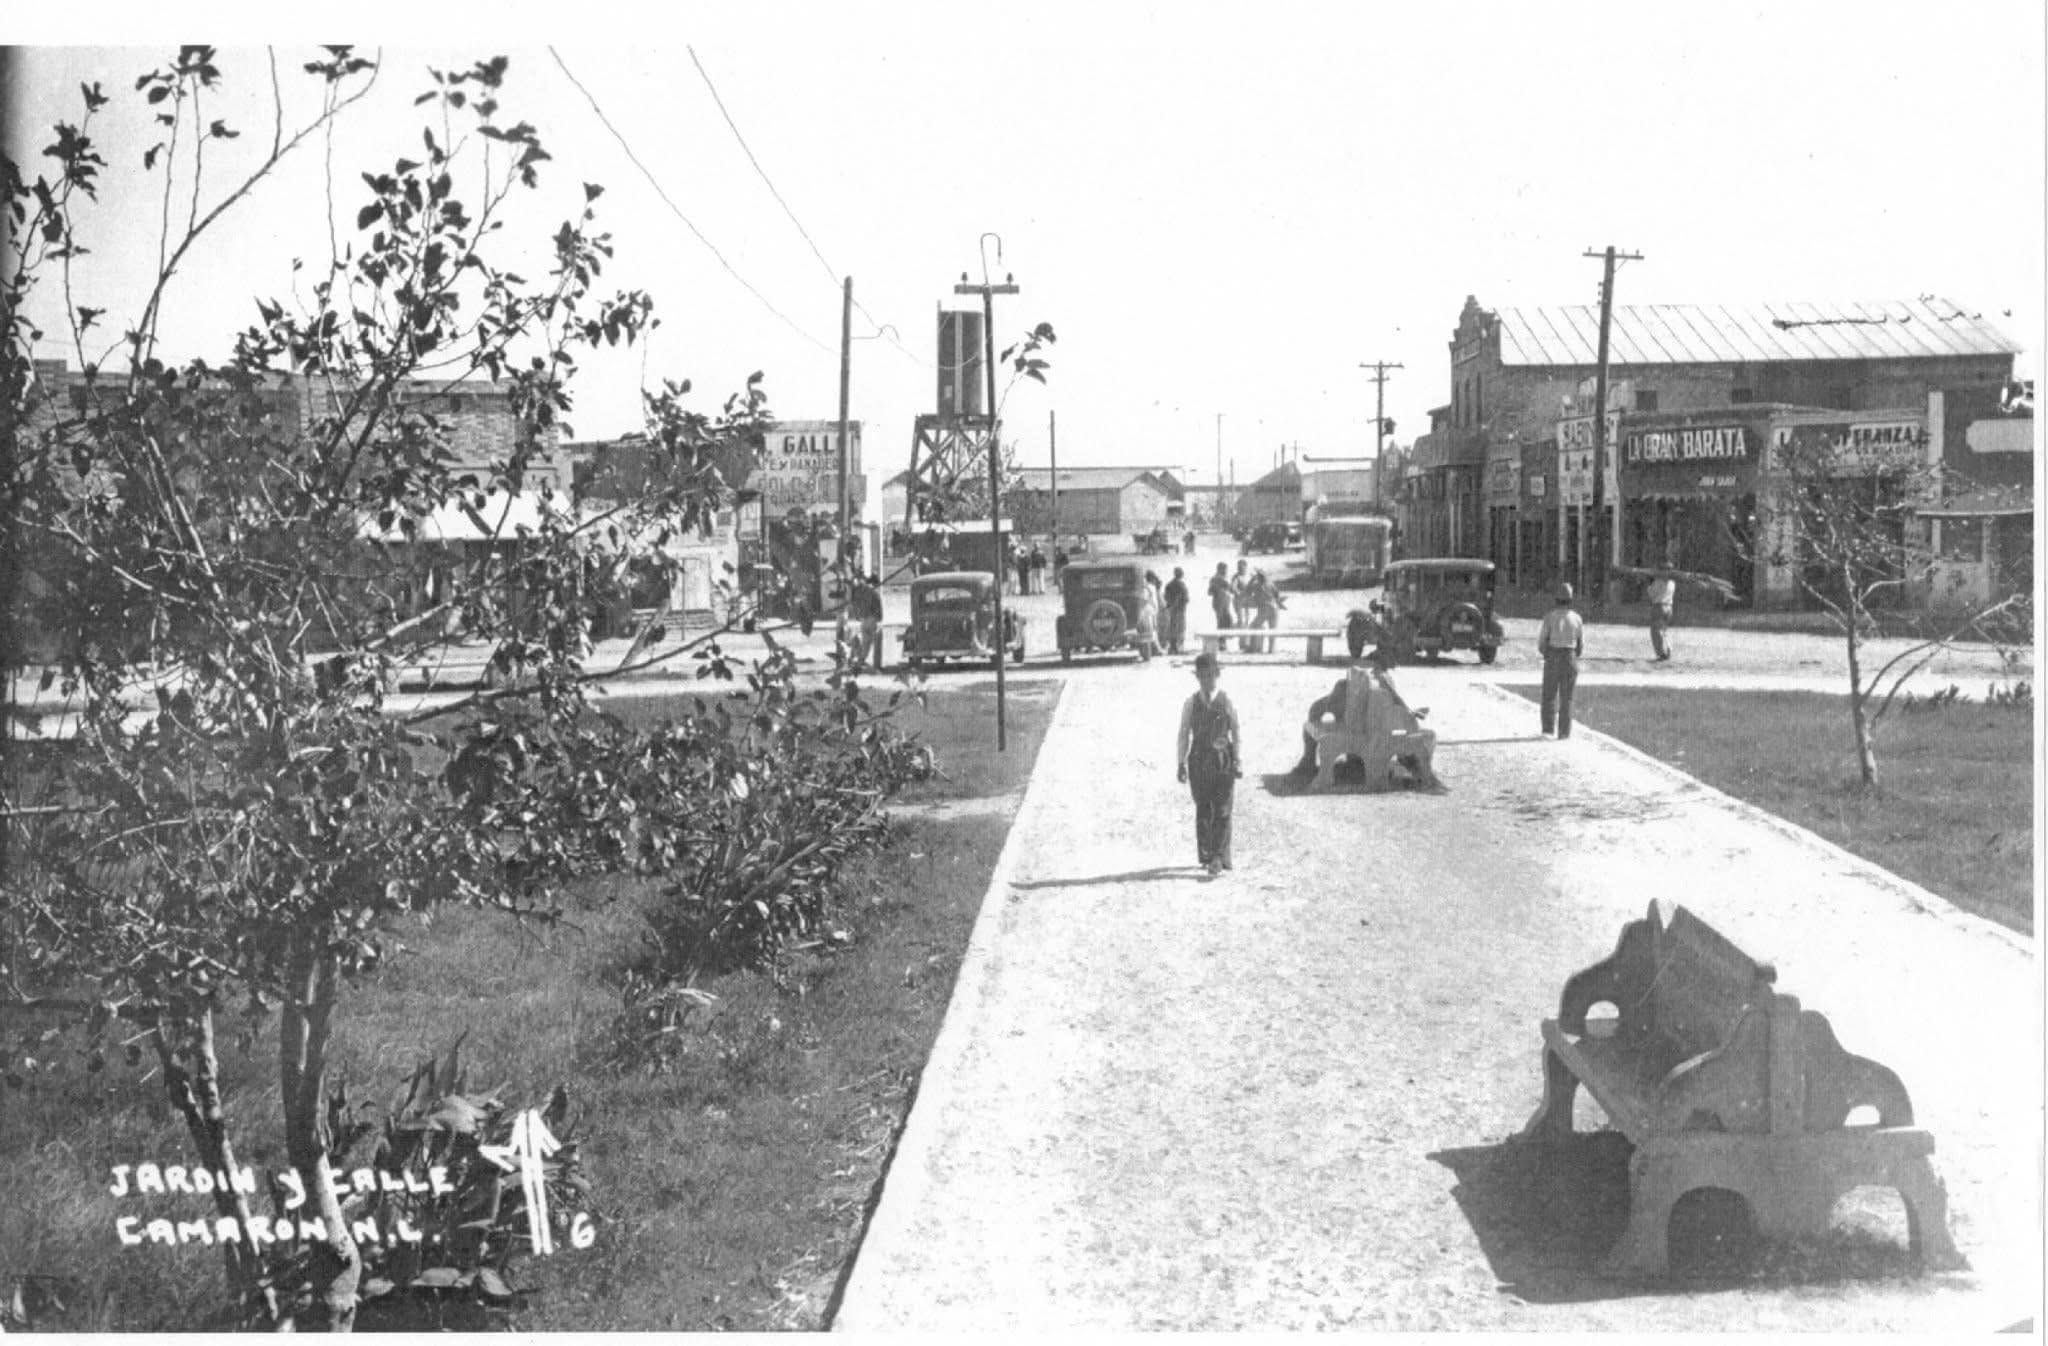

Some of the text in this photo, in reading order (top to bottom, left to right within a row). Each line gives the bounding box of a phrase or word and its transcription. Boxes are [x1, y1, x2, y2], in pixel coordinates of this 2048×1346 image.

[1628, 435, 1640, 461] LA
[1643, 432, 1678, 462] GRAN
[1683, 427, 1747, 459] BARATA
